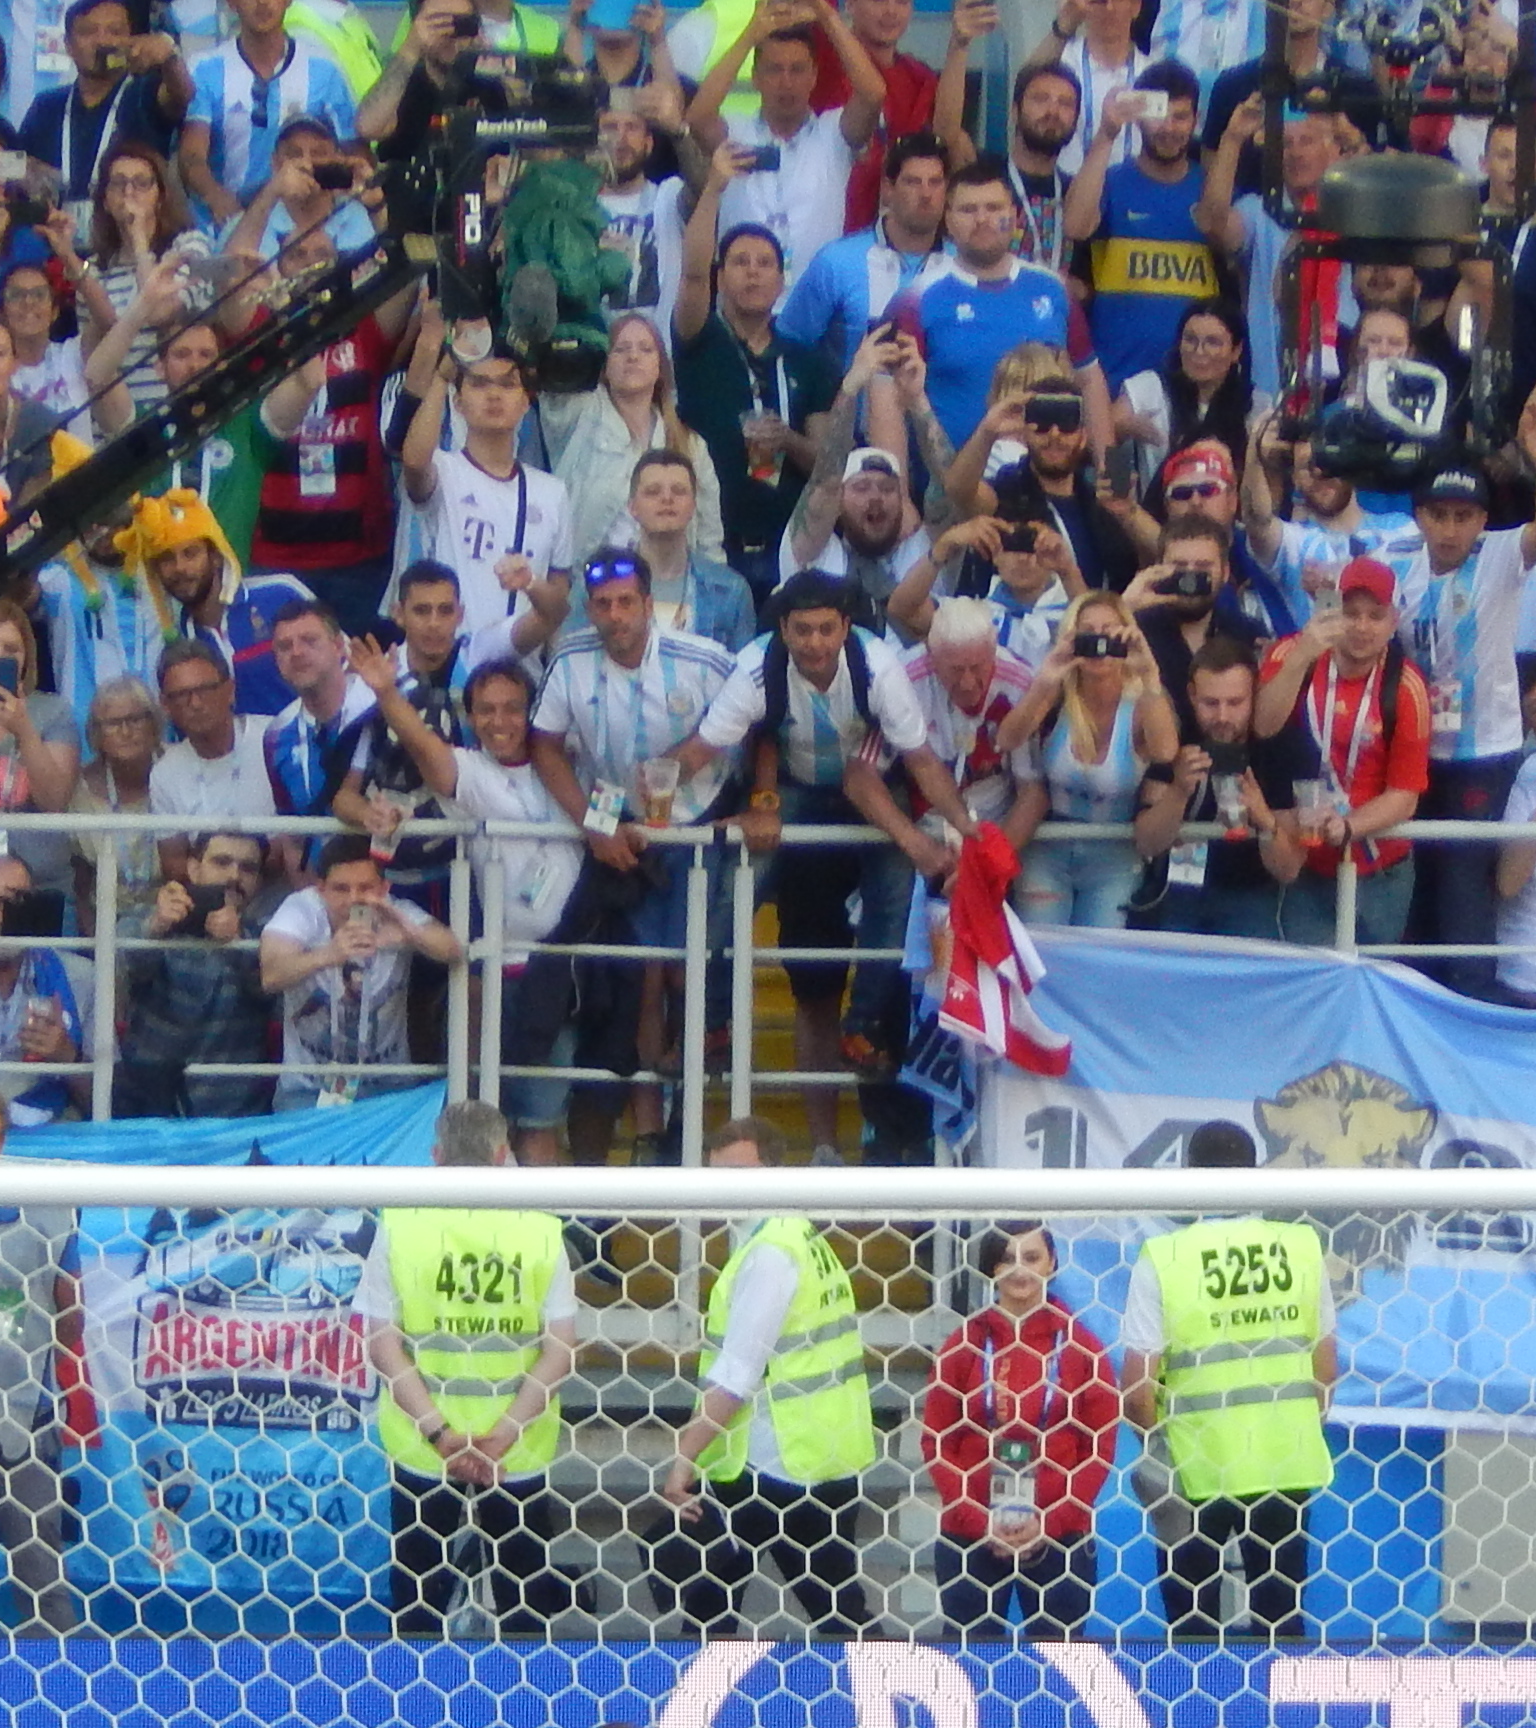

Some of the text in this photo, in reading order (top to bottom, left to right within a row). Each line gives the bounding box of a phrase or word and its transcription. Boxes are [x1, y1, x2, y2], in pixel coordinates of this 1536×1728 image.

[475, 118, 548, 135] MovieTech
[1128, 251, 1207, 286] BBVA
[465, 517, 494, 560] T
[436, 1251, 522, 1304] 4321
[1201, 1241, 1293, 1299] 5253
[434, 1316, 524, 1334] STEWARD
[1210, 1304, 1299, 1328] SEWARD
[145, 1302, 367, 1390] ARGENTINA
[213, 1491, 349, 1526] RUSSA
